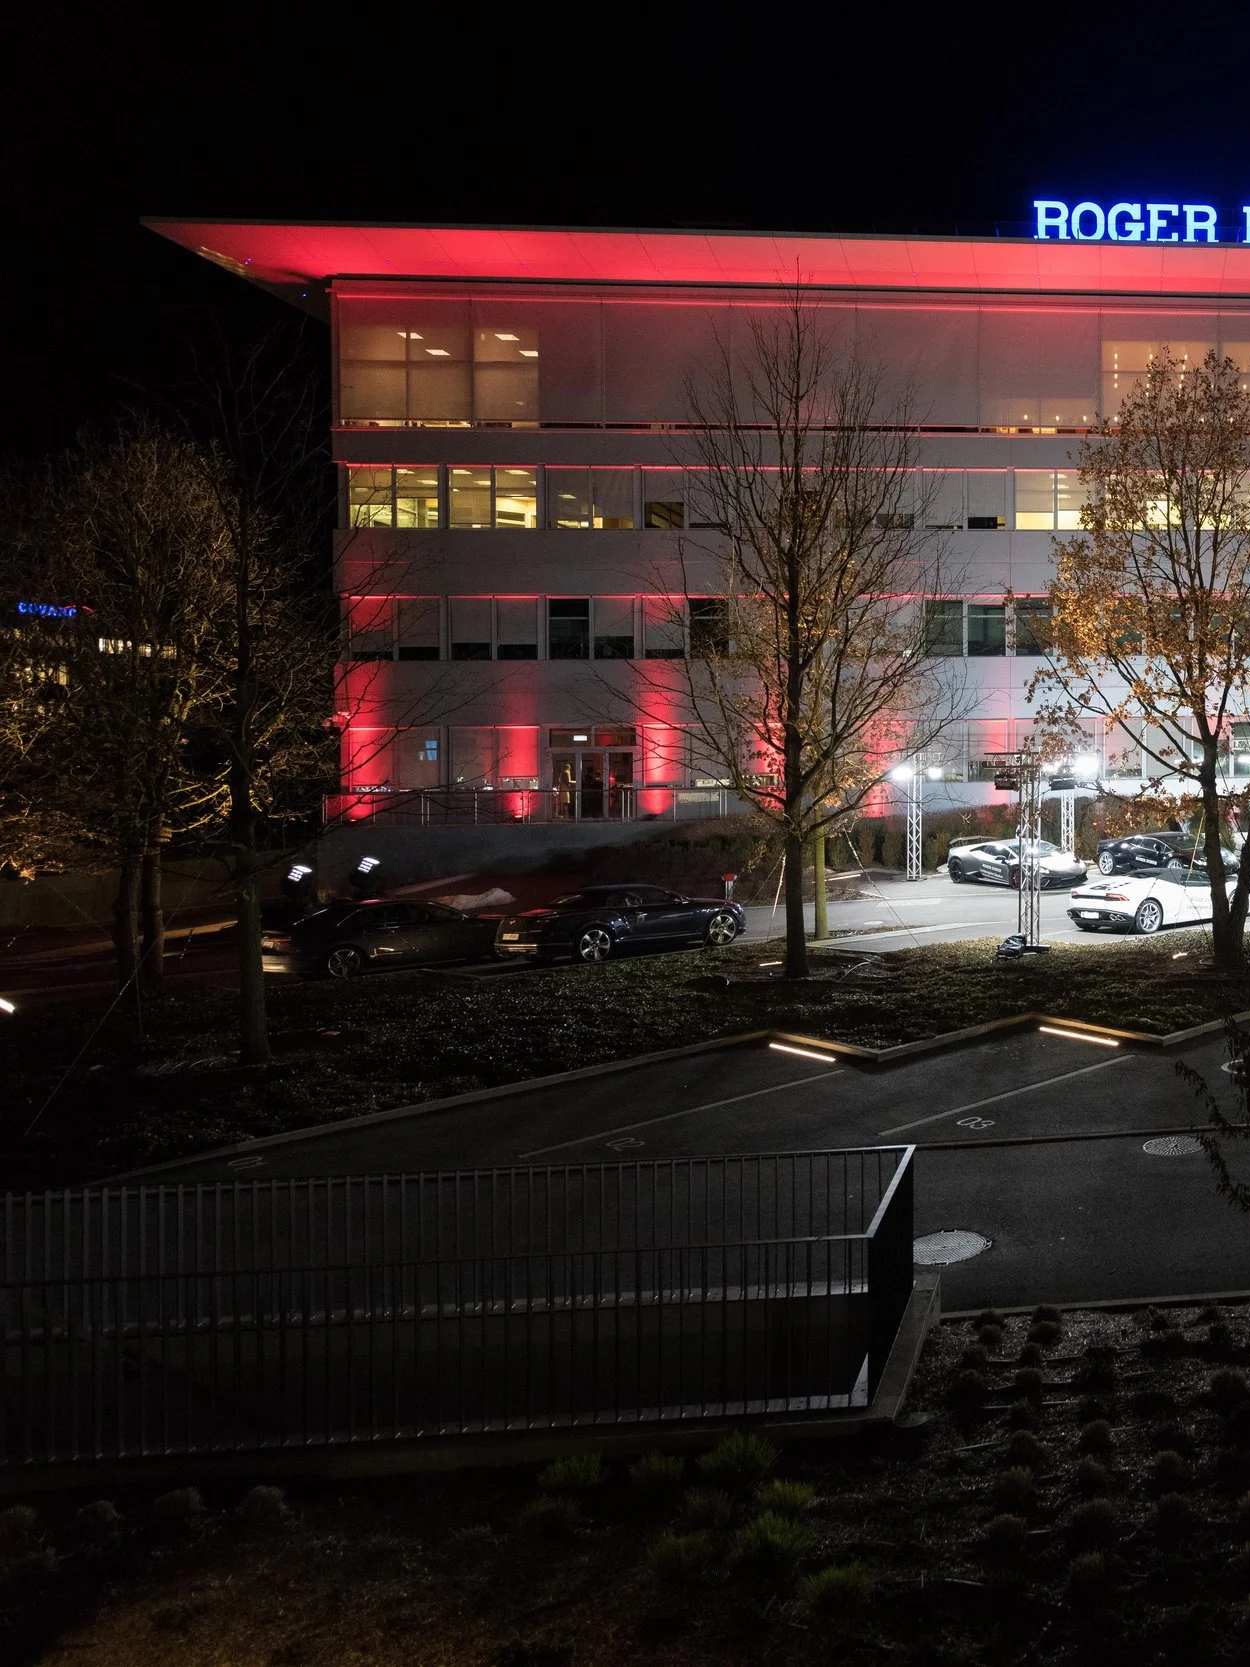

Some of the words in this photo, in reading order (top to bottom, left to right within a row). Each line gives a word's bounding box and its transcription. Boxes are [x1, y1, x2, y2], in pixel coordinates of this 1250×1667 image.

[1033, 200, 1219, 243] ROGER
[956, 1116, 995, 1130] 03
[605, 1137, 646, 1151] 02
[227, 1156, 269, 1171] 01
